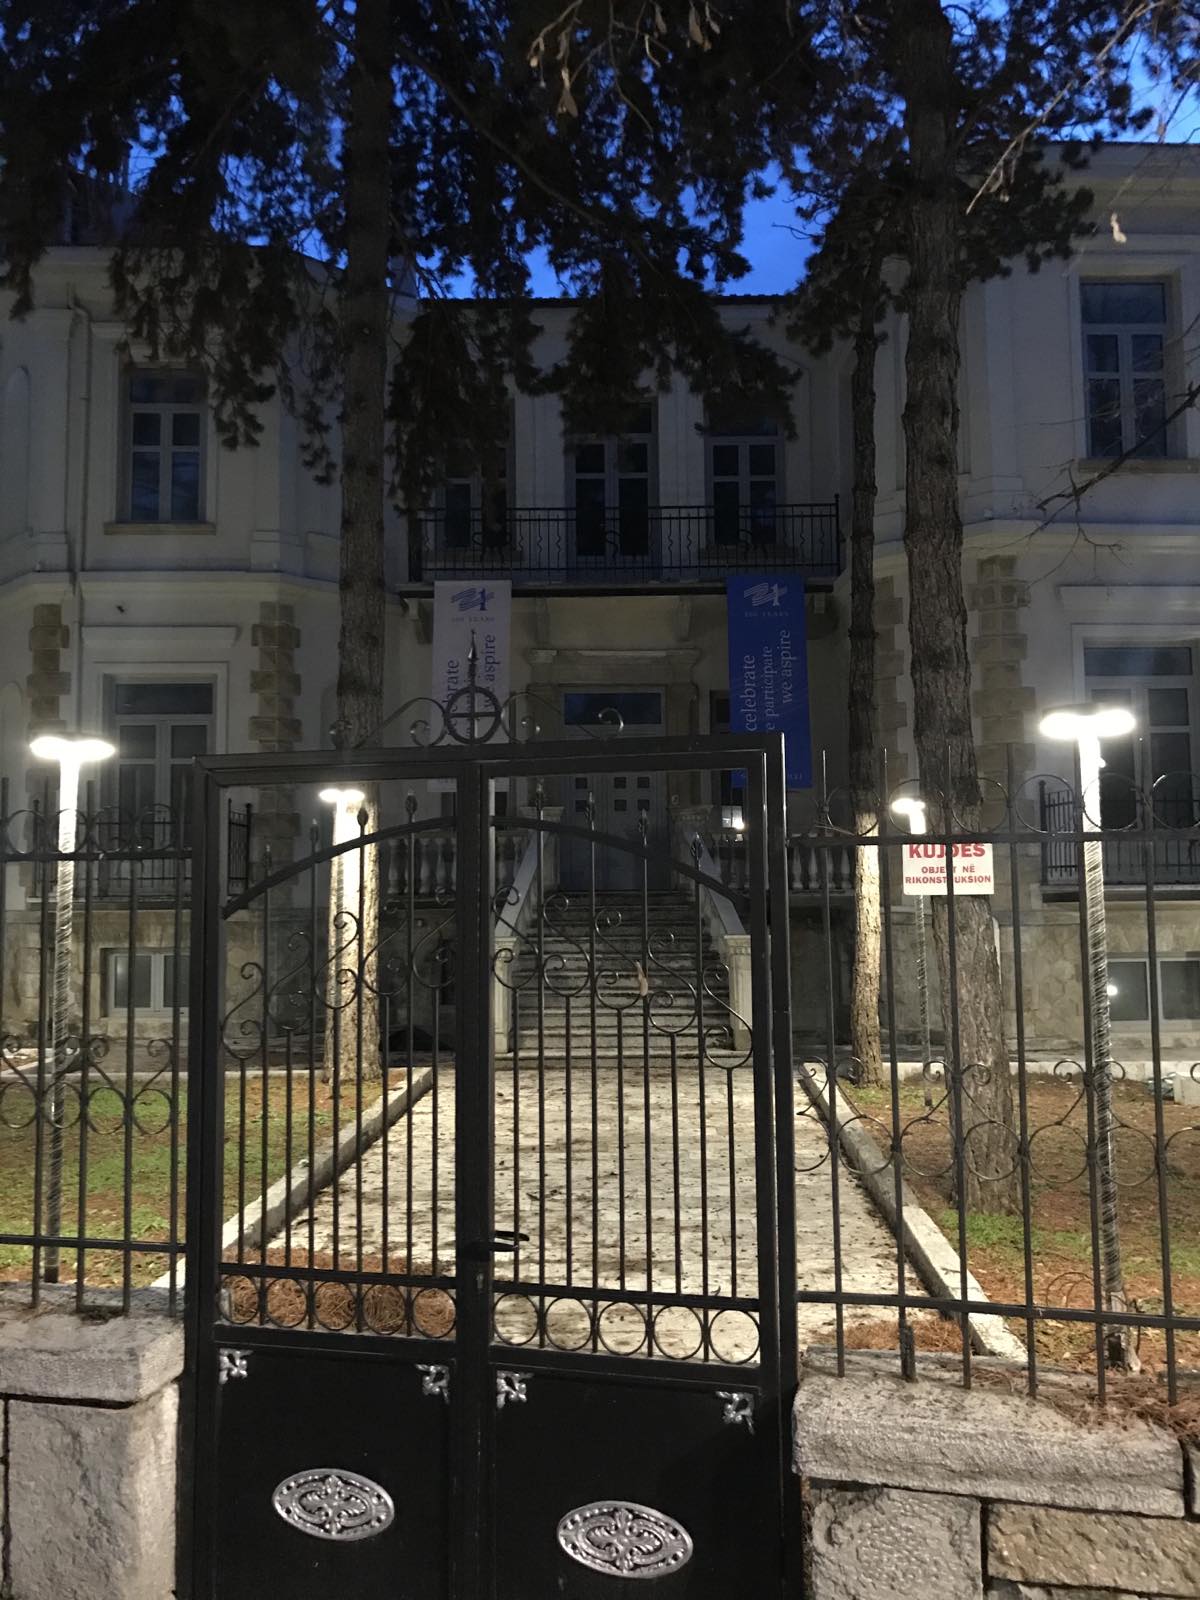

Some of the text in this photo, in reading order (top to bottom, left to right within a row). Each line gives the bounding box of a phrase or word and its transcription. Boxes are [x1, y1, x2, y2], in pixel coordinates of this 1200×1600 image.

[481, 634, 500, 682] aspire
[760, 646, 780, 718] participate
[777, 629, 798, 704] we aspire
[739, 655, 758, 732] celebrate
[905, 875, 991, 884] RIKONSTUKSION
[921, 864, 976, 874] OBJET NË
